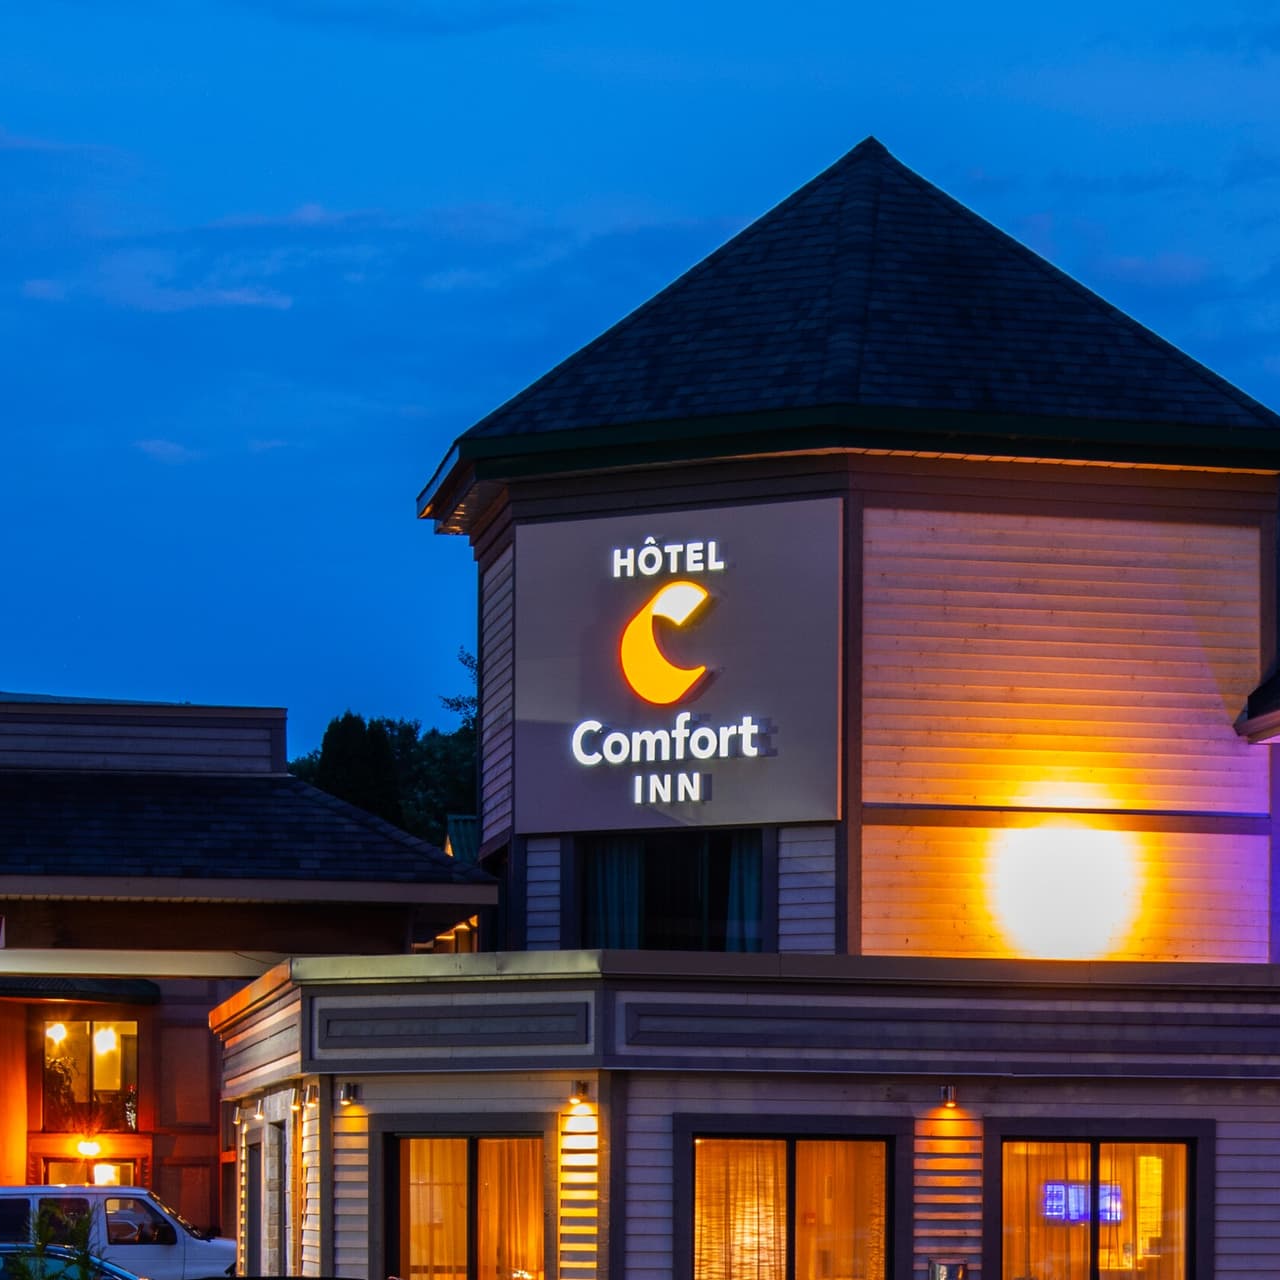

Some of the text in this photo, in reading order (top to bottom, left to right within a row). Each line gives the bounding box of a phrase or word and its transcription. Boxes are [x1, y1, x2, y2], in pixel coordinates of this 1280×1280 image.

[613, 536, 725, 577] HÔTEL
[571, 711, 759, 766] Comfort
[634, 772, 701, 804] INN
